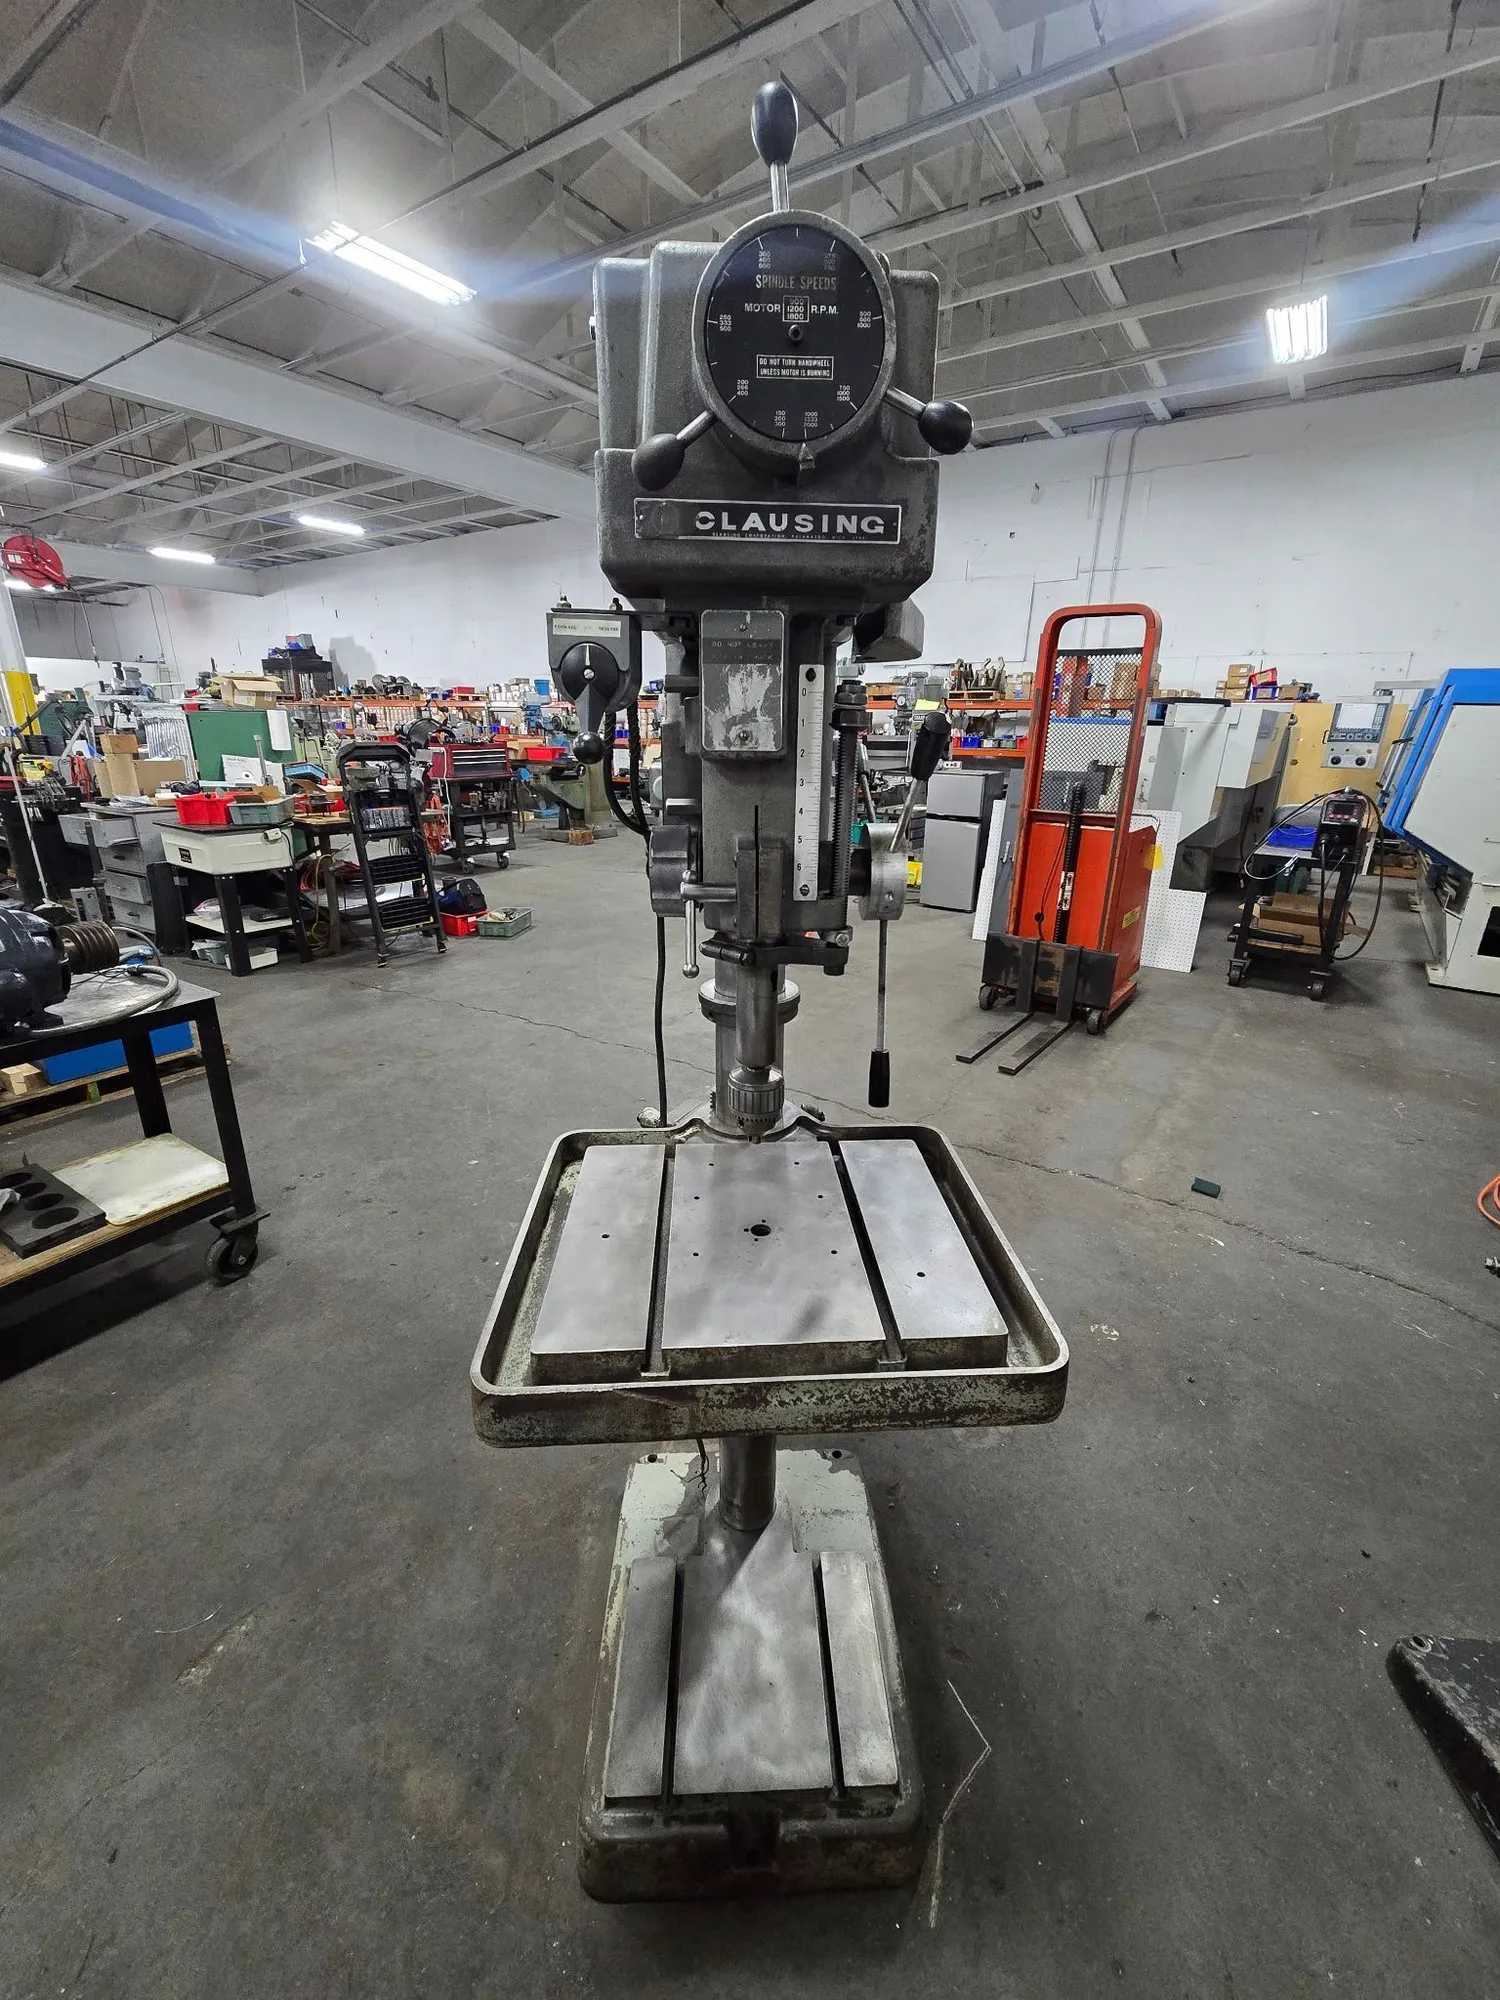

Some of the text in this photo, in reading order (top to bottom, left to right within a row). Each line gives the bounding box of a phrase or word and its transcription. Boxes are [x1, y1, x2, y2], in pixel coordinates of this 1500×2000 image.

[755, 274, 837, 290] SPINDLE SPEEDS
[744, 303, 781, 312] MOTOR
[810, 305, 839, 315] R.P.M.
[769, 358, 779, 366] NOT
[782, 358, 796, 367] TURN
[798, 359, 830, 367] HANDWHEEL
[760, 368, 780, 376] UNLESS
[807, 369, 830, 377] RUNNING
[695, 511, 885, 534] CLAUSING
[801, 687, 807, 697] 0
[801, 718, 805, 727] 1
[800, 749, 805, 758] 2
[799, 778, 805, 787] 3
[798, 807, 804, 816] 4
[797, 835, 803, 844] 5
[796, 863, 802, 871] 6
